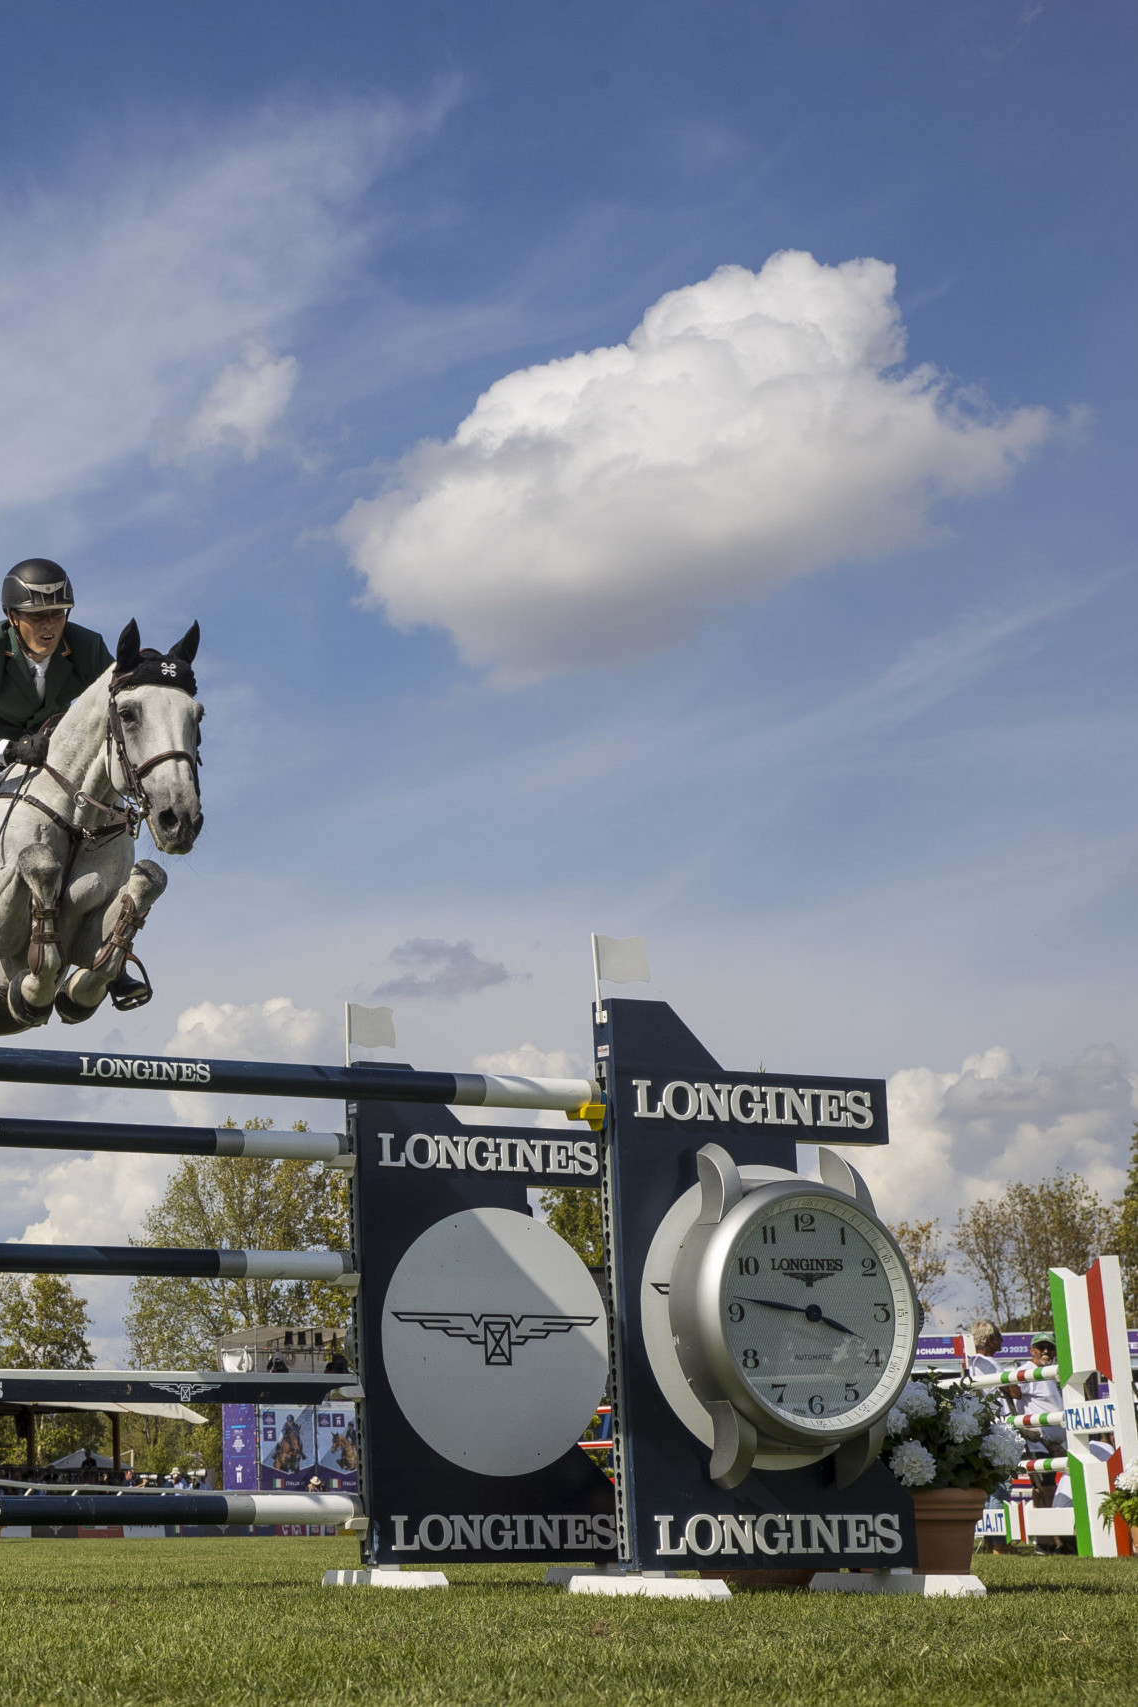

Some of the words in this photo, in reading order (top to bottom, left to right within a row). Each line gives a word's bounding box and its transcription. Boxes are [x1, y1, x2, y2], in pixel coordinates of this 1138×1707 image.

[80, 1056, 211, 1084] LONGINES
[633, 1077, 874, 1130] LONGINES
[378, 1132, 599, 1176] LONGINES
[794, 1213, 816, 1232] 12
[762, 1225, 776, 1244] 11
[839, 1227, 846, 1245] 1
[738, 1256, 760, 1276] 10
[770, 1258, 844, 1272] LONGINES
[861, 1258, 877, 1277] 2
[728, 1303, 745, 1322] 9
[873, 1303, 891, 1322] 3
[742, 1348, 760, 1369] 8
[794, 1353, 832, 1361] AUTOMATIC
[864, 1349, 884, 1368] 4
[920, 1347, 955, 1355] CHAMPIO
[771, 1383, 788, 1403] 7
[844, 1382, 860, 1402] 5
[808, 1394, 825, 1415] 6
[1064, 1404, 1115, 1431] ITALIA.IT
[391, 1513, 618, 1551] LONGINES
[975, 1512, 1004, 1532] LIA.IT
[654, 1514, 904, 1557] LONGINES
